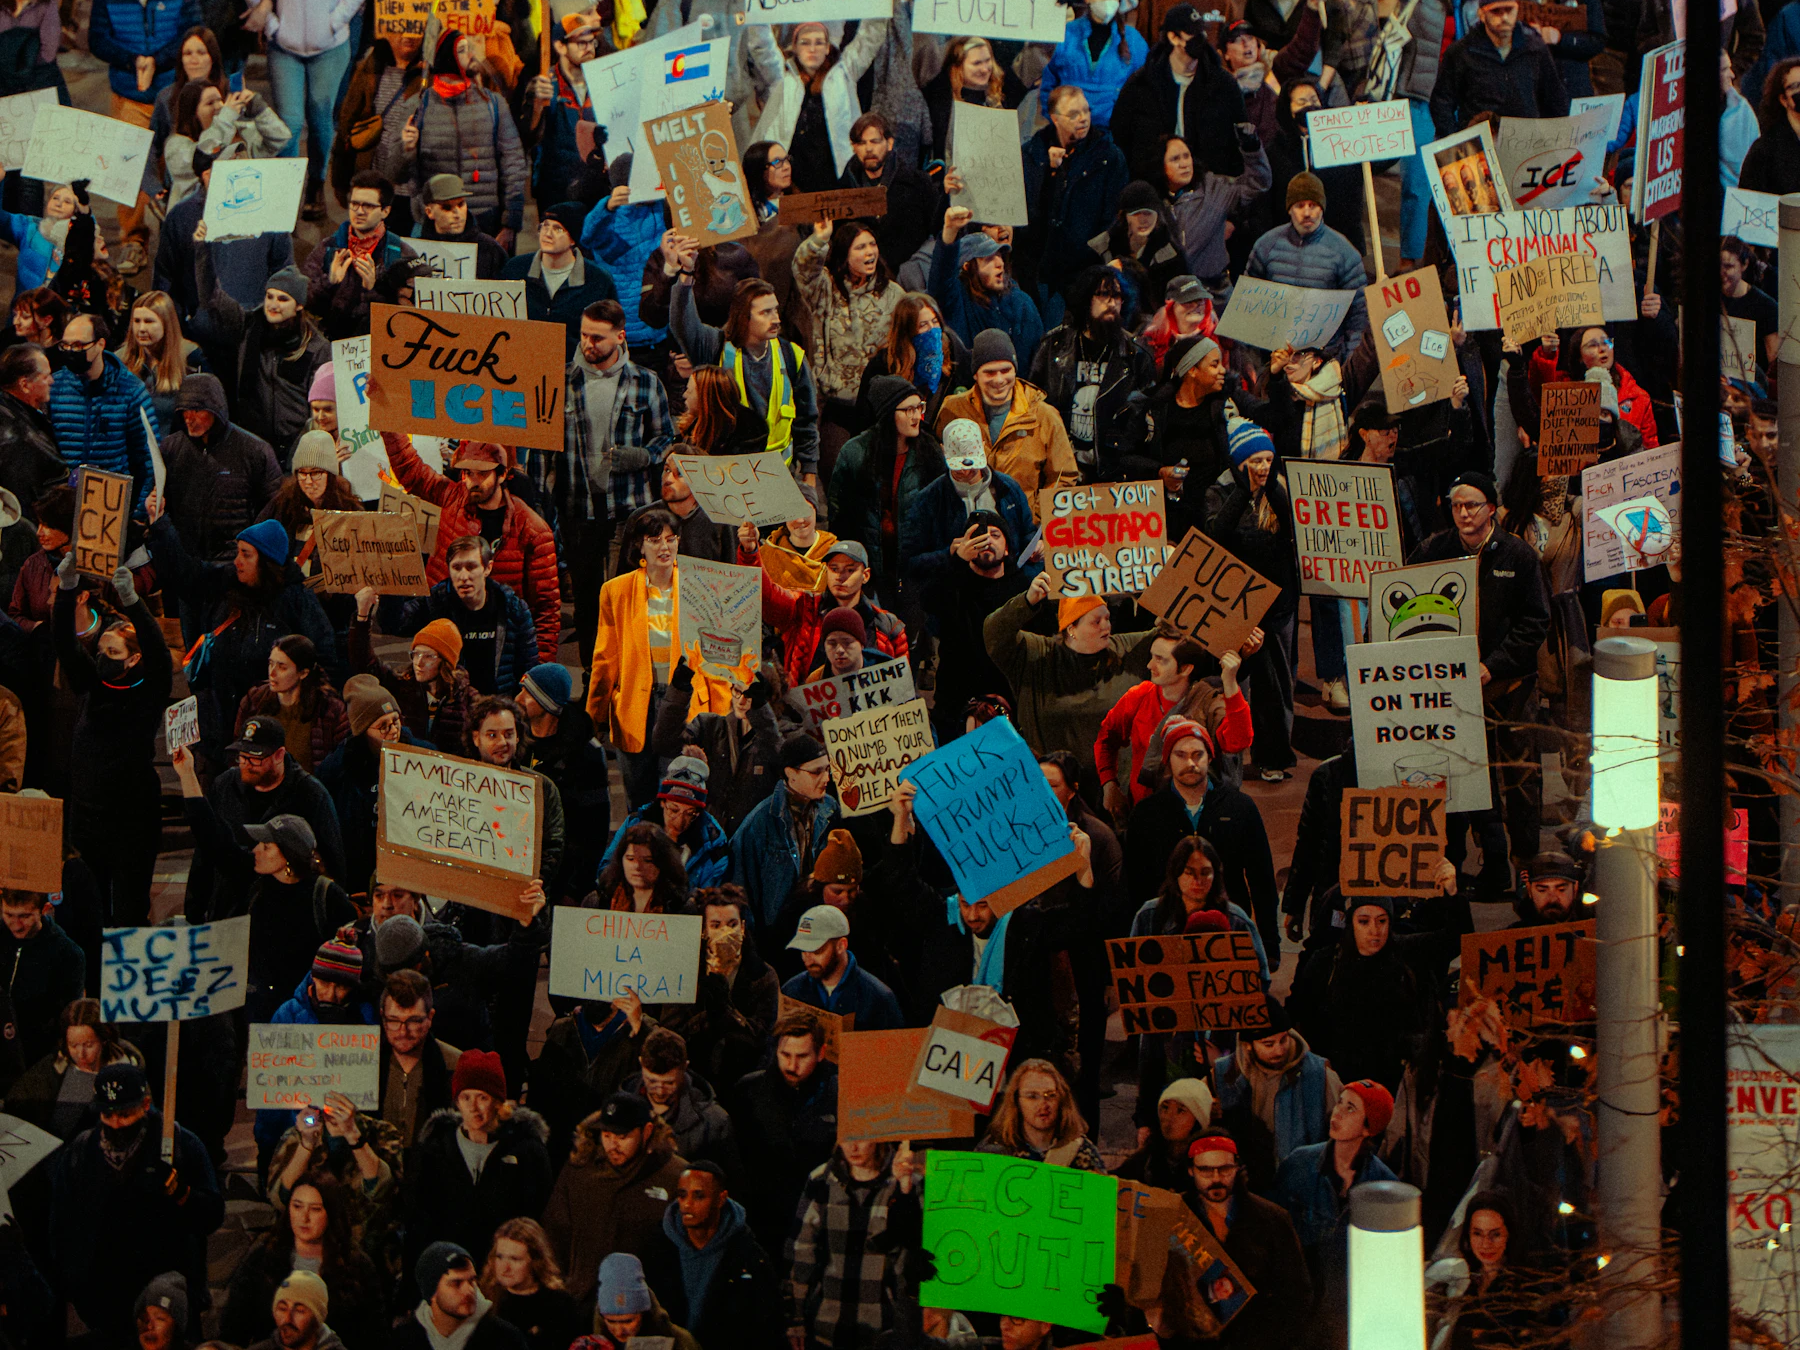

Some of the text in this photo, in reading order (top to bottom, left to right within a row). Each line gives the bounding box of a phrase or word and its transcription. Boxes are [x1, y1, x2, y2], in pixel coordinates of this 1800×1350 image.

[450, 0, 470, 11] THE
[1668, 81, 1678, 104] IS
[651, 111, 707, 146] MELT
[1313, 105, 1407, 127] STAND UP NOW
[1321, 129, 1411, 160] PROTEST
[1656, 137, 1676, 175] US
[1520, 160, 1585, 189] ICE
[668, 162, 693, 228] ICE
[1461, 204, 1627, 243] ITS NOT ABOUT
[1486, 232, 1598, 267] CRIMINALS
[1382, 277, 1421, 308] NO
[1461, 265, 1480, 295] IF
[1494, 254, 1597, 308] LAND FREE
[416, 289, 522, 318] HISTORY
[1386, 323, 1408, 340] Ice
[1424, 337, 1443, 352] Ice
[341, 342, 359, 358] May
[382, 311, 518, 385] Fuck
[409, 379, 527, 429] ICE
[1546, 389, 1599, 406] PRISON
[1543, 417, 1565, 430] DUE
[1551, 428, 1579, 444] IS A
[679, 458, 780, 486] FUCK
[1297, 472, 1385, 502] LAND OF THE
[83, 475, 123, 512] FU
[696, 490, 765, 519] ICE
[1052, 485, 1156, 518] get your
[80, 509, 118, 545] CK
[1044, 510, 1164, 549] GESTAPO
[1294, 498, 1389, 530] GREED
[322, 521, 417, 562] Keep Immigrants
[1304, 527, 1392, 558] HOME OF THE
[76, 546, 117, 575] ICE
[1053, 546, 1156, 572] outta our
[325, 566, 424, 587] Deport Kristi Noem
[1171, 532, 1269, 620] FUCK
[1164, 585, 1227, 648] ICE
[802, 662, 906, 706] NO TRUMP
[1359, 661, 1468, 685] FASCISM
[809, 686, 892, 724] NO KKK
[1369, 691, 1453, 713] ON THE
[828, 708, 924, 744] DONT LET THEM
[1376, 723, 1457, 744] ROCKS
[848, 731, 932, 763] NUMB YOUR
[389, 753, 532, 804] IMMIGRANTS
[911, 736, 1004, 807] FUCK
[429, 790, 481, 813] MAKE
[928, 759, 1034, 842] TRUMP!
[401, 801, 497, 839] AMERICA
[1348, 797, 1443, 838] FUCK
[417, 826, 496, 860] GREAT!
[955, 804, 1032, 879] FUCK
[586, 914, 669, 942] CHINGA
[103, 926, 219, 965] ICE
[615, 944, 643, 964] LA
[1110, 934, 1257, 968] NO ICE
[583, 968, 684, 998] MIGRA!
[1117, 972, 1174, 1004] NO
[103, 996, 211, 1022] NUTS
[1123, 1003, 1269, 1033] NO KINGS
[258, 1031, 379, 1051] WHEN CRUELTY
[251, 1052, 316, 1069] BECOMES
[924, 1043, 996, 1088] CAVA
[256, 1073, 341, 1087] COMPASSION
[263, 1091, 312, 1104] LOOKS
[927, 1157, 1084, 1224] ICE
[932, 1229, 1105, 1304] OUT!
